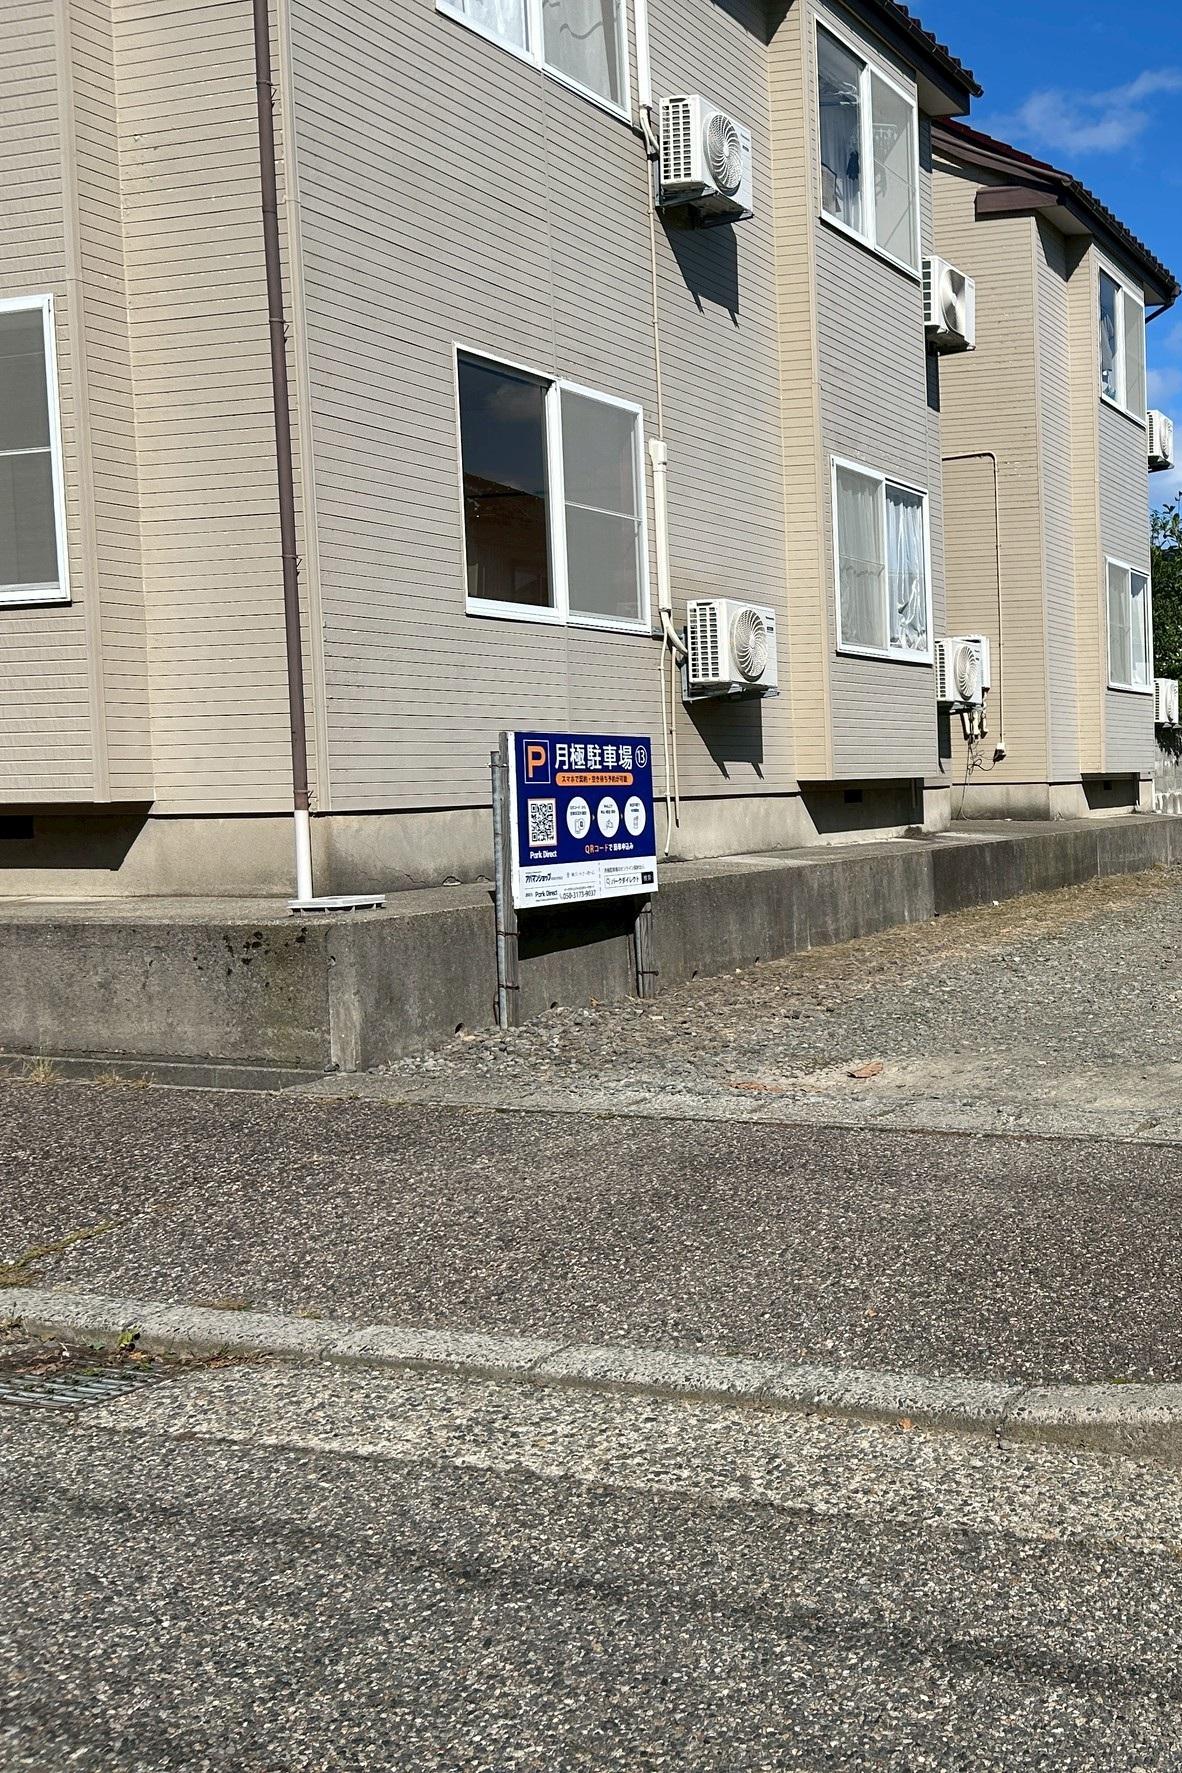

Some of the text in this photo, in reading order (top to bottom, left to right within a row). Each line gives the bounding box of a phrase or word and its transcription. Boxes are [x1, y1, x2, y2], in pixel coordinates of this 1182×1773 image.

[527, 745, 546, 778] P
[555, 743, 633, 770] 月極駐車場
[529, 849, 558, 860] Park Direct
